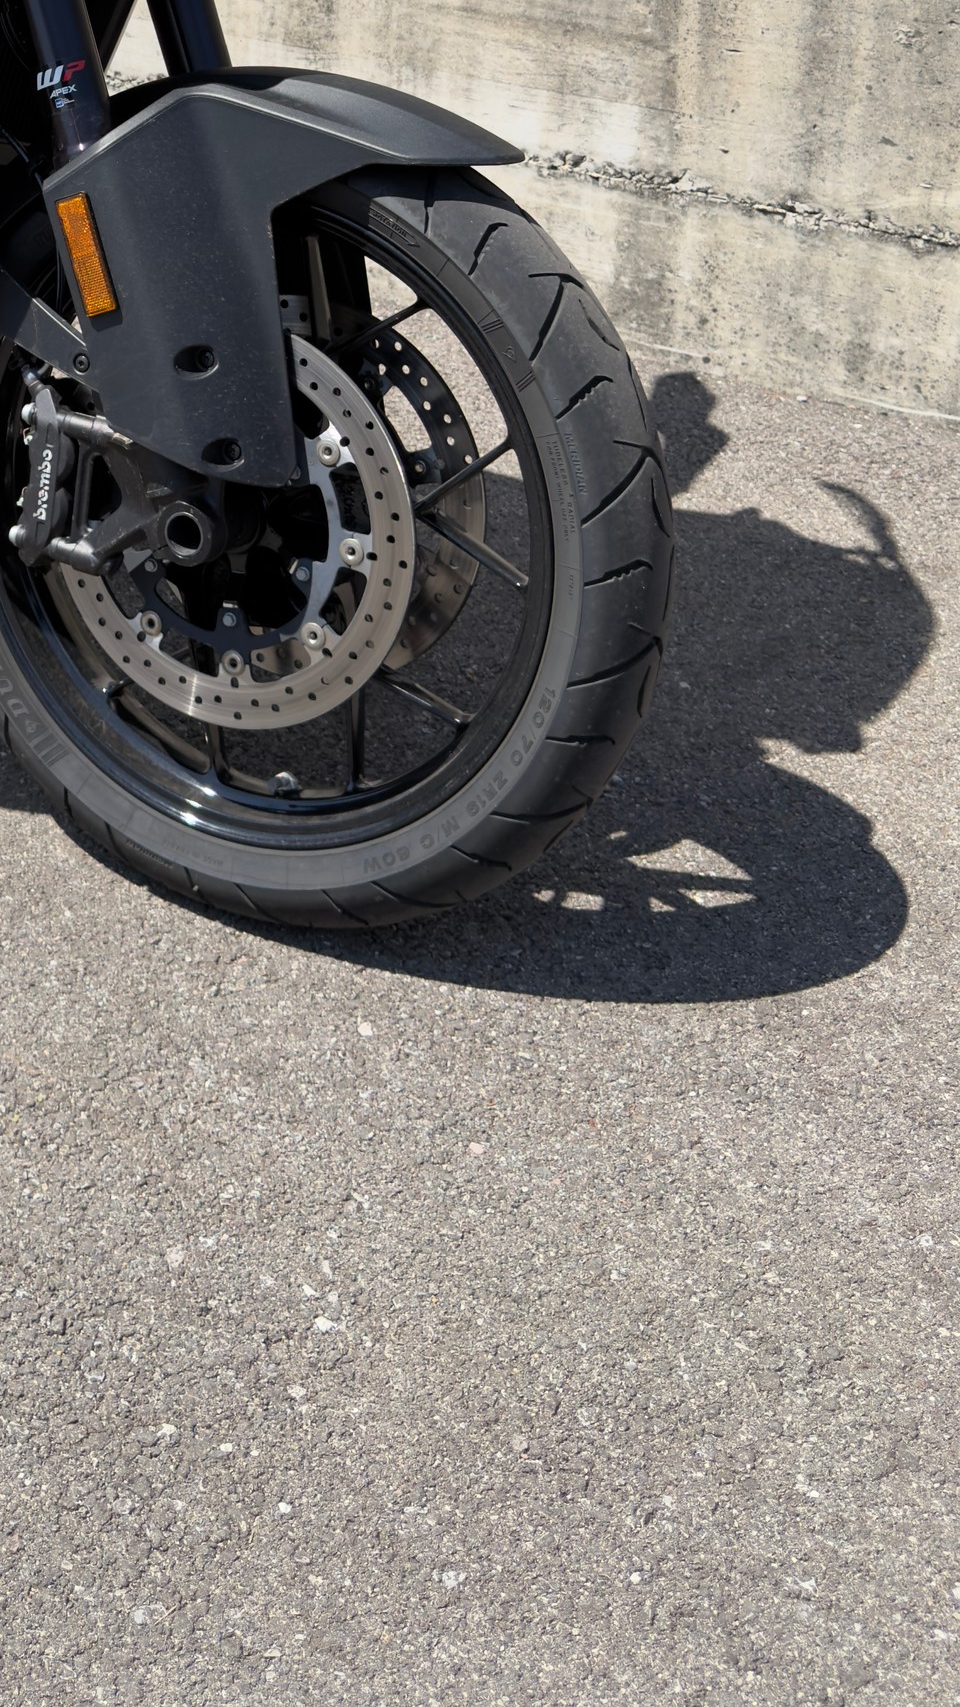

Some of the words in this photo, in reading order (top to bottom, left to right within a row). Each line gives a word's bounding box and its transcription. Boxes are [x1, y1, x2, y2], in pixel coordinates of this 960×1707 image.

[36, 59, 86, 91] WP
[49, 84, 77, 99] APEX
[33, 449, 53, 521] brembo
[509, 686, 556, 767] 120/70
[419, 816, 461, 850] M/C
